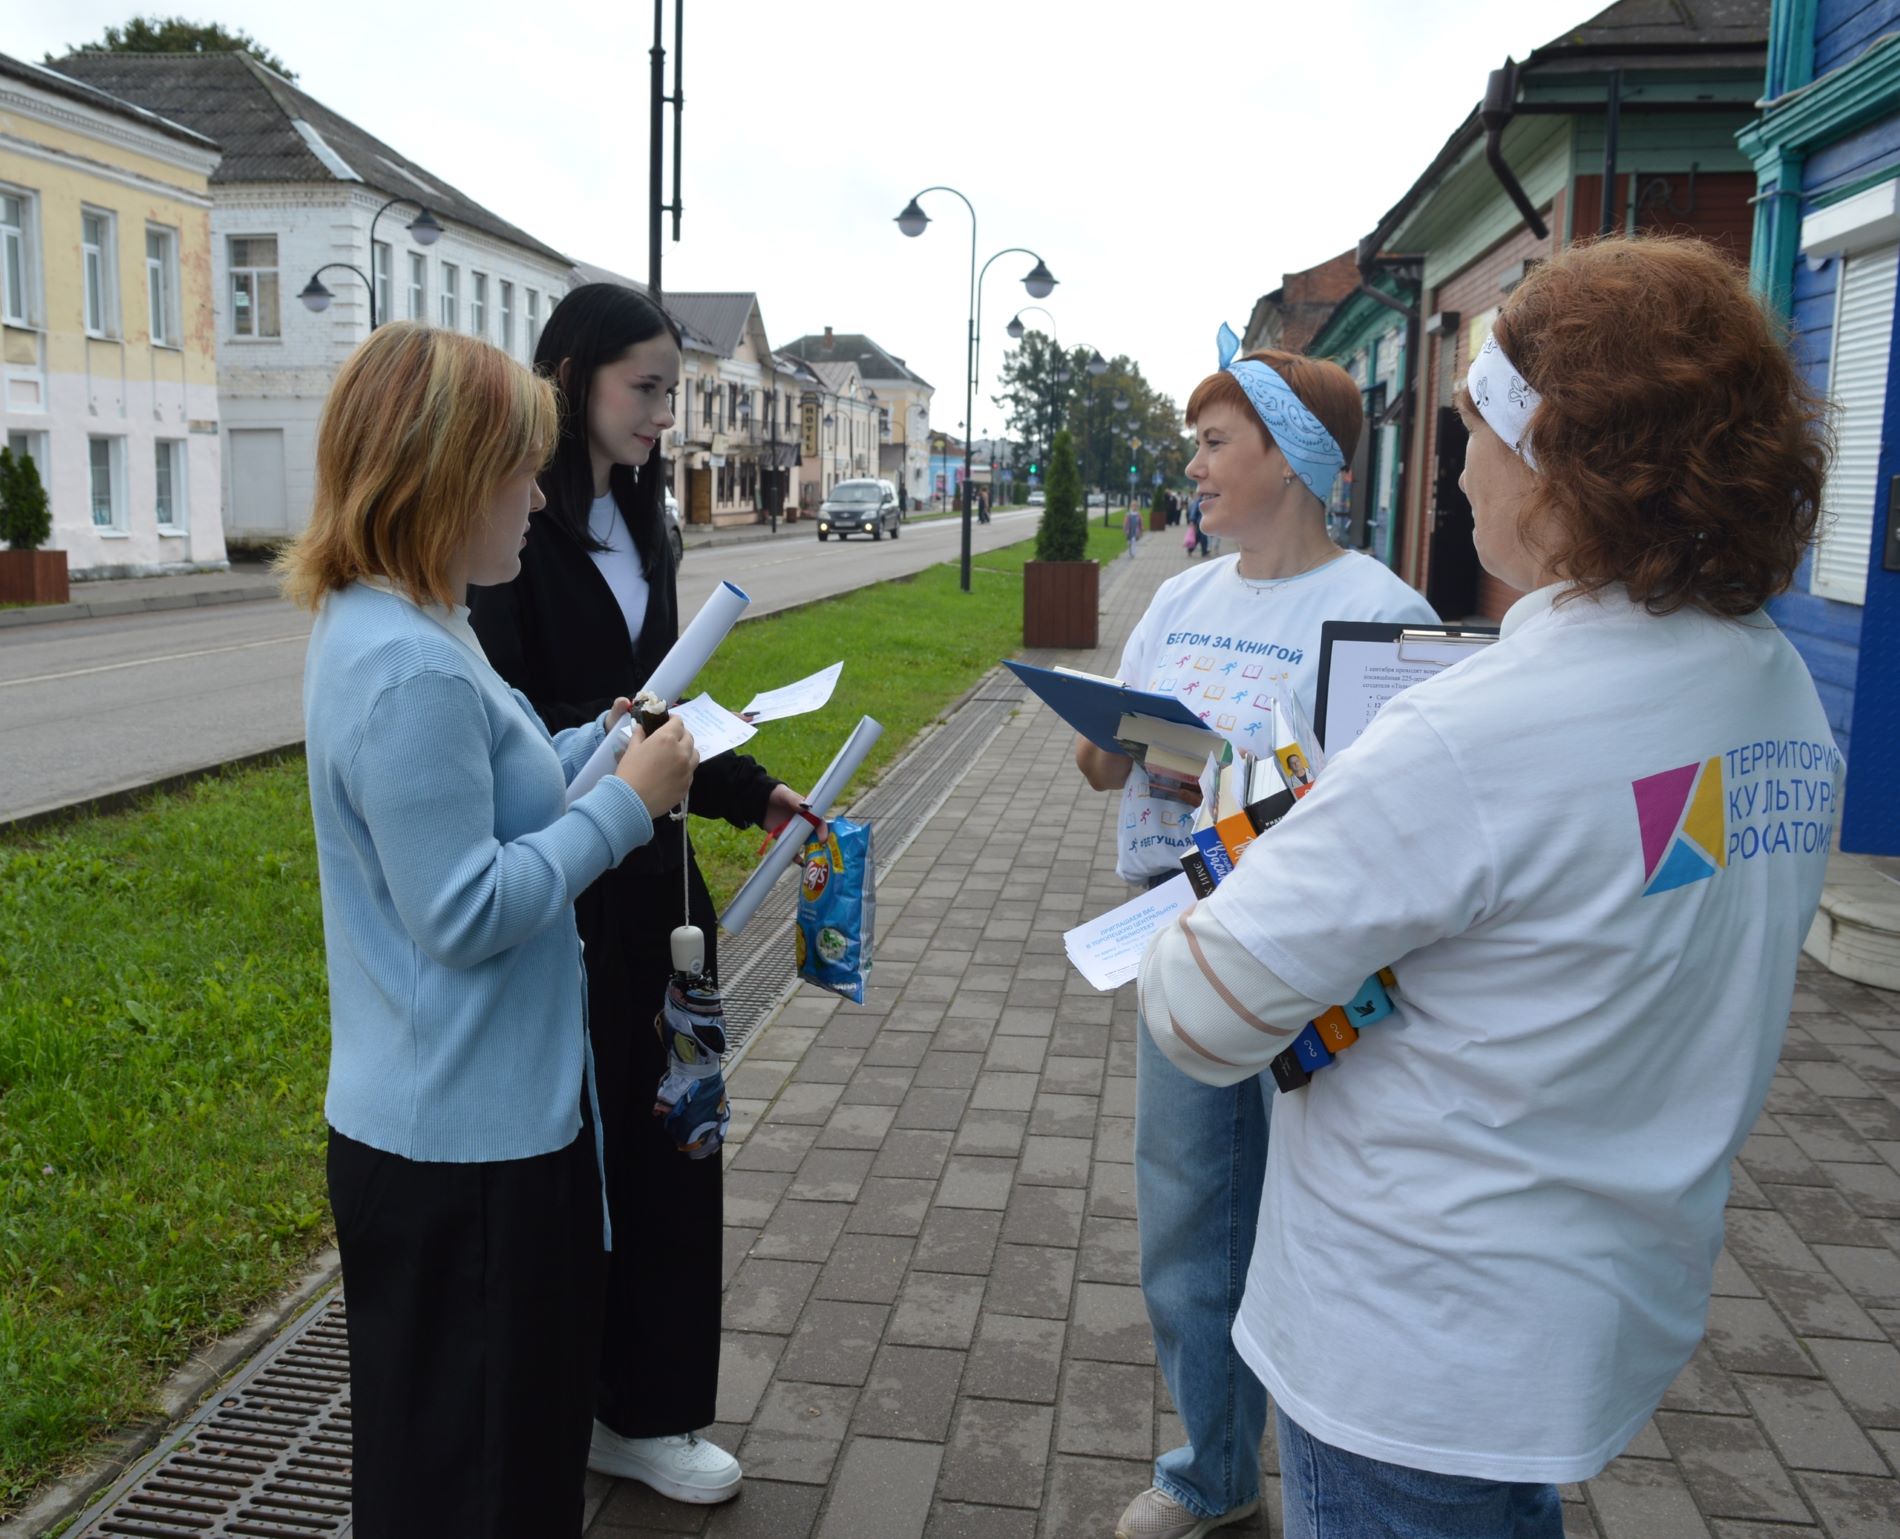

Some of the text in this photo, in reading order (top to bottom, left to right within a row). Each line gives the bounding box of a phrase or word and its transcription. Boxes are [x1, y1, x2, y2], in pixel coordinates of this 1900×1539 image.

[806, 407, 814, 451] HOTEL
[1166, 632, 1304, 665] БЕГОМ ЗА КНИГОЙ
[1726, 740, 1840, 778] ТЕРРИТОРИЯ
[1727, 821, 1834, 866] РОСАТОМ
